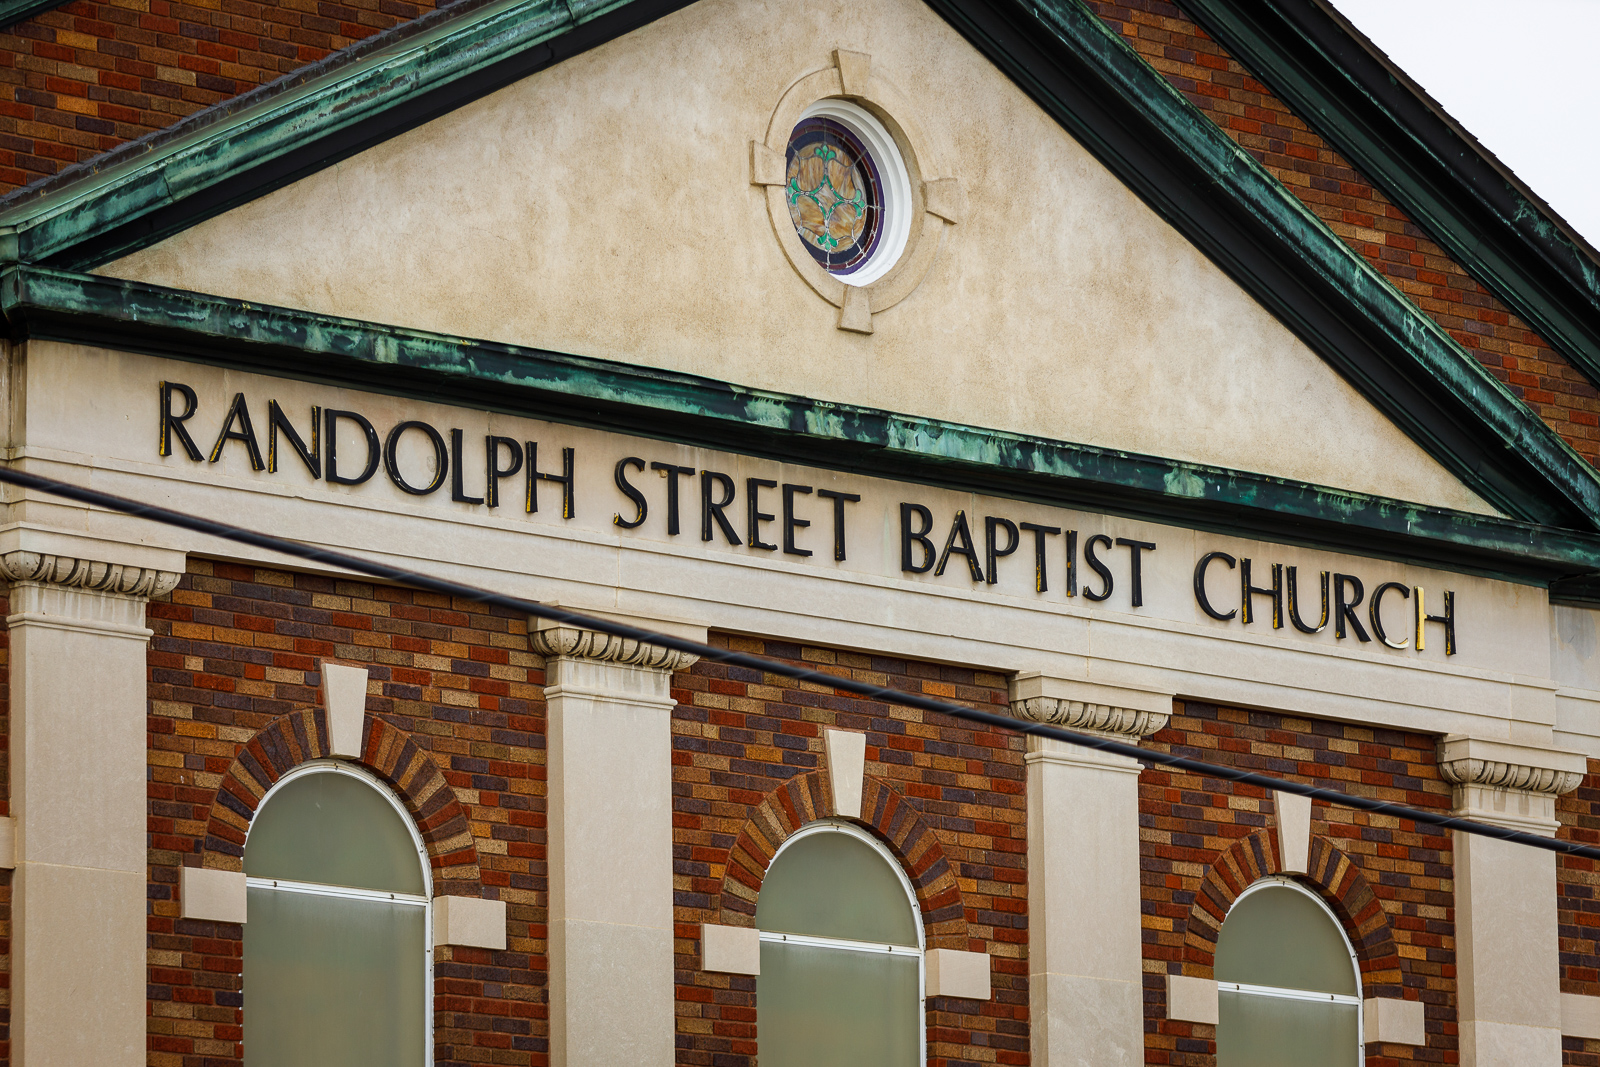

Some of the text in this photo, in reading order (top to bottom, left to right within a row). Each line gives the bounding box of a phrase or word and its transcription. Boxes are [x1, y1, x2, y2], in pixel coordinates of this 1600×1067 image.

[159, 380, 1457, 656] RANDOLPH STREET BAPTIST CHURCH
